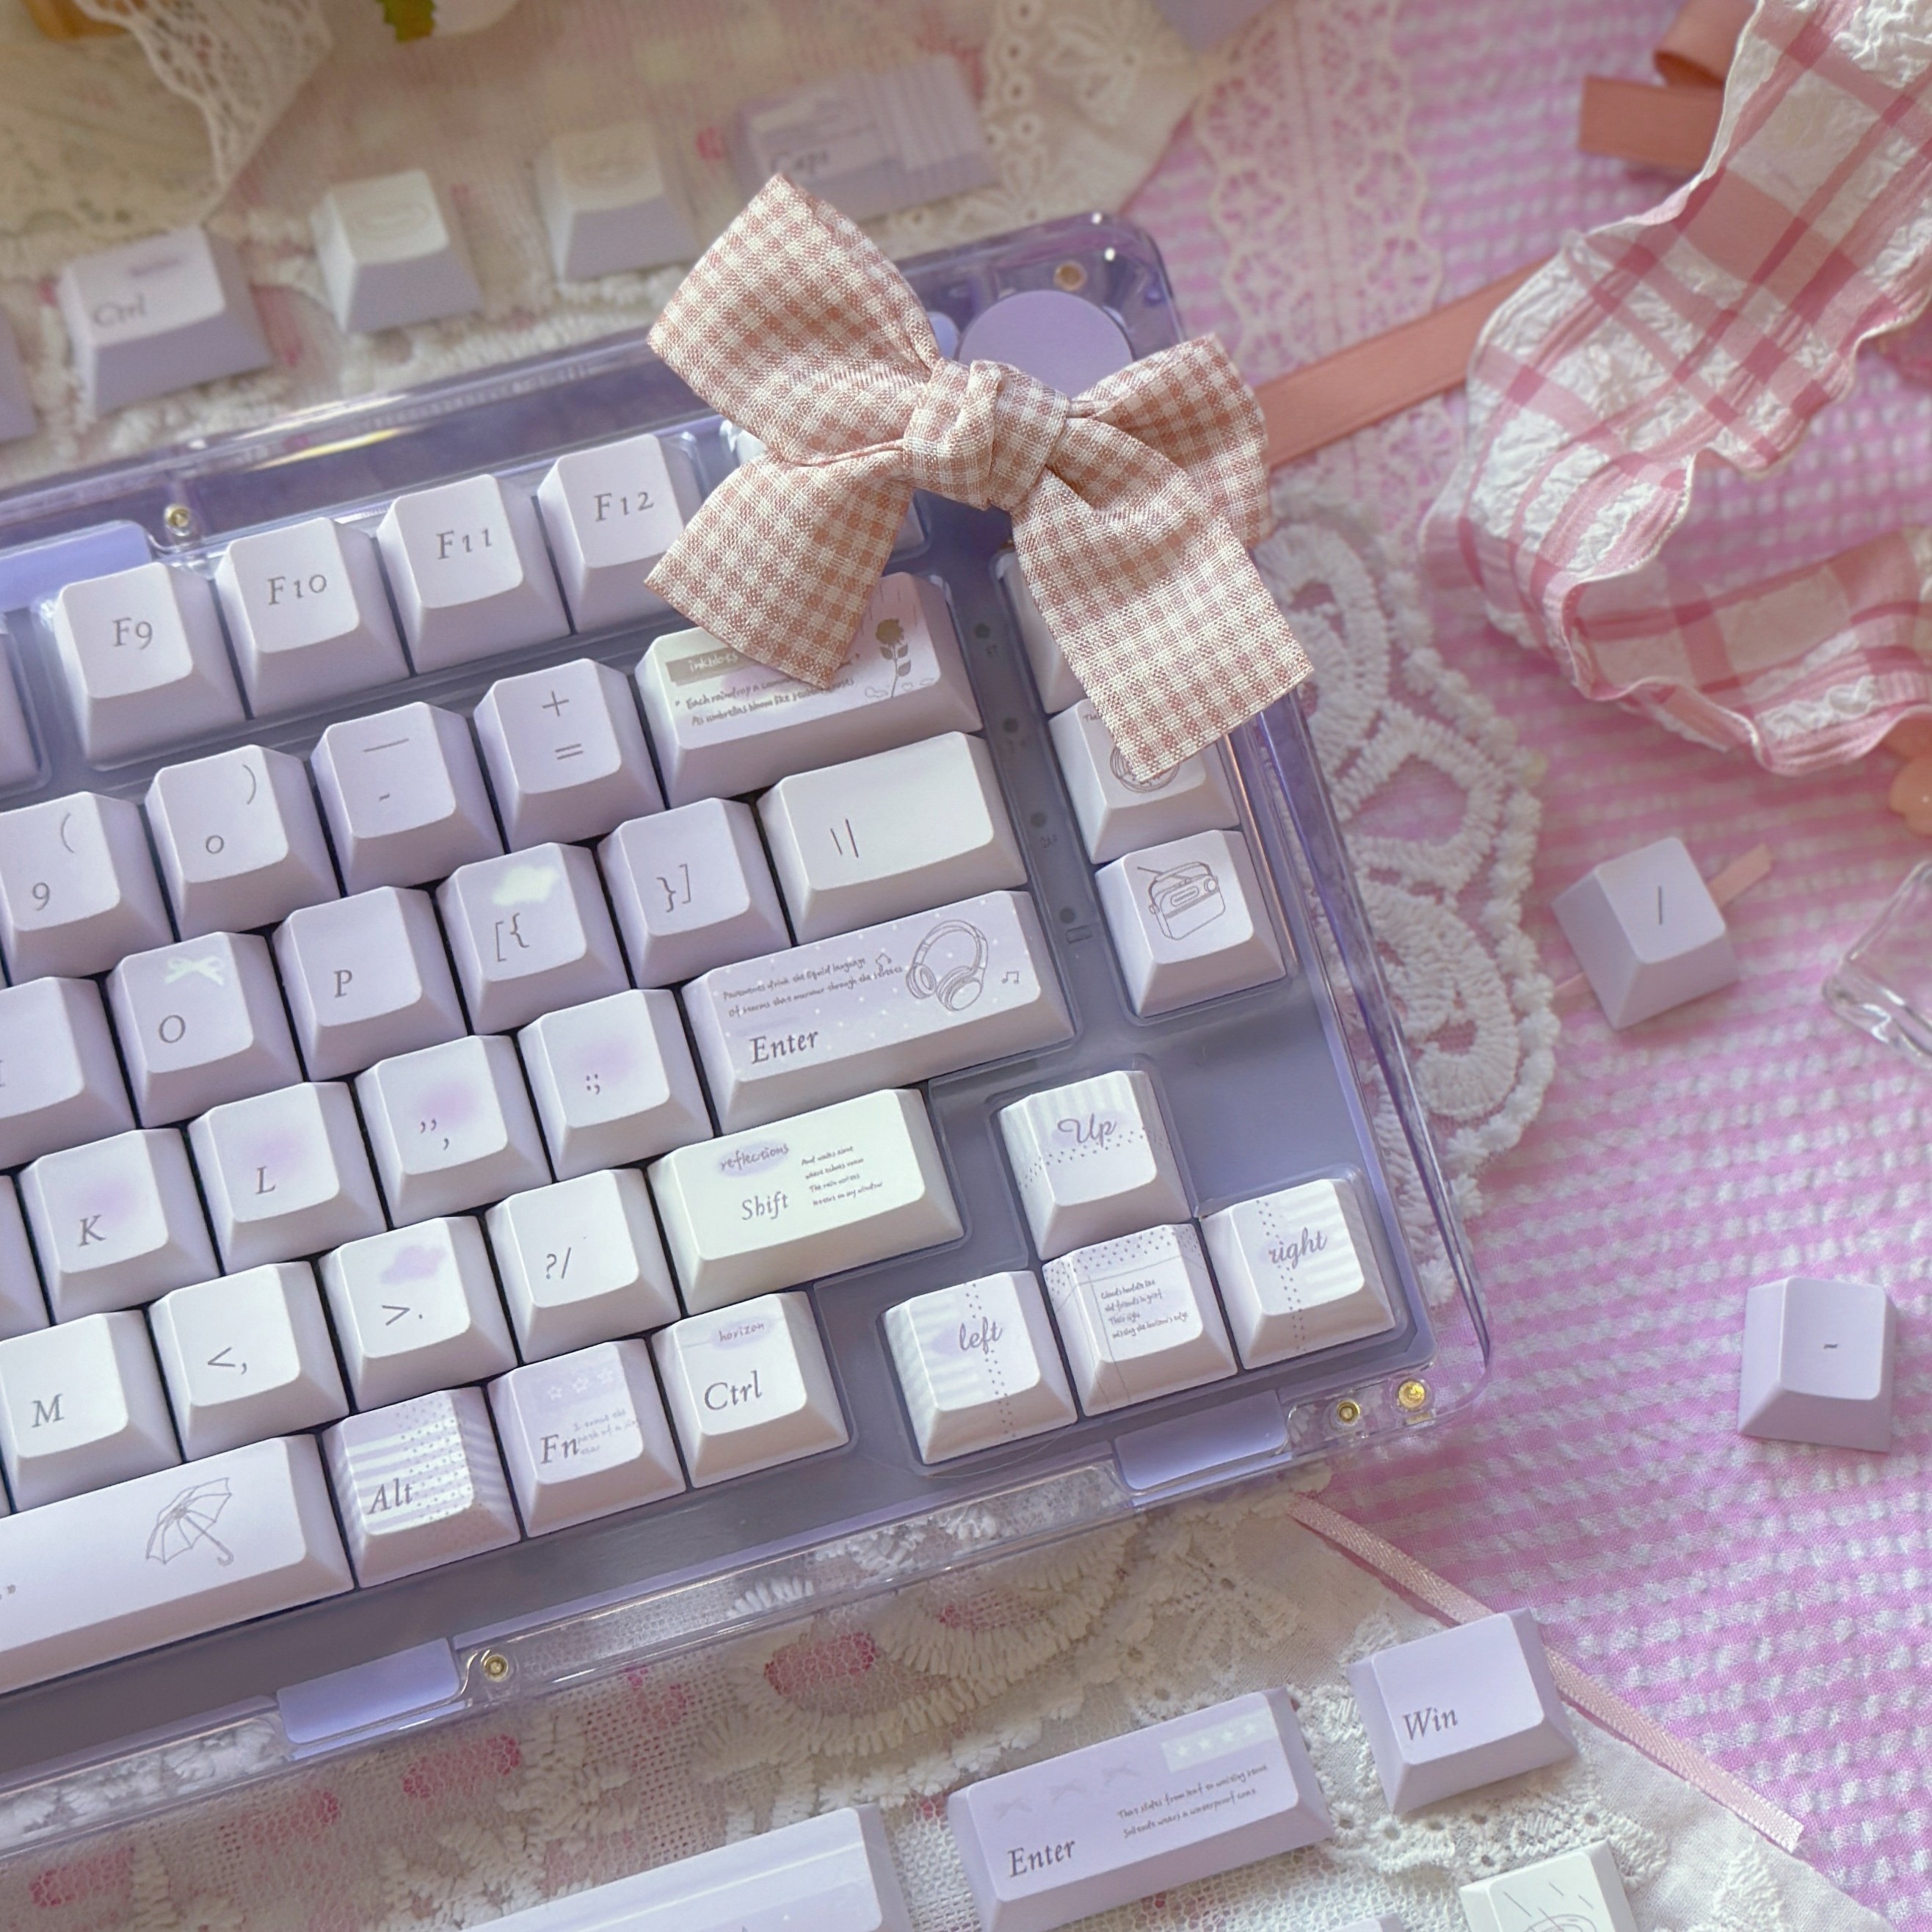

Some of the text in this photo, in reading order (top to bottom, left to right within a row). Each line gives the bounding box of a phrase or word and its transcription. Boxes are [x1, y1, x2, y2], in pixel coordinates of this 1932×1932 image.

[595, 492, 654, 522] F12
[437, 529, 492, 559] F11
[268, 574, 327, 605] F10
[113, 617, 153, 649] F9
[32, 882, 50, 911] 9
[335, 970, 352, 998] P
[159, 1015, 186, 1043] O
[749, 1031, 818, 1064] Enter
[1057, 1116, 1116, 1146] Up
[256, 1166, 275, 1194] L
[741, 1191, 789, 1221] Shift
[79, 1215, 106, 1246] K
[1268, 1227, 1328, 1269] right
[959, 1323, 1003, 1351] left
[704, 1370, 763, 1411] Ctrl
[32, 1394, 64, 1428] M
[540, 1434, 579, 1464] Fn
[367, 1477, 415, 1516] Alt
[1403, 1707, 1458, 1740] Win
[1008, 1841, 1075, 1877] Enter
